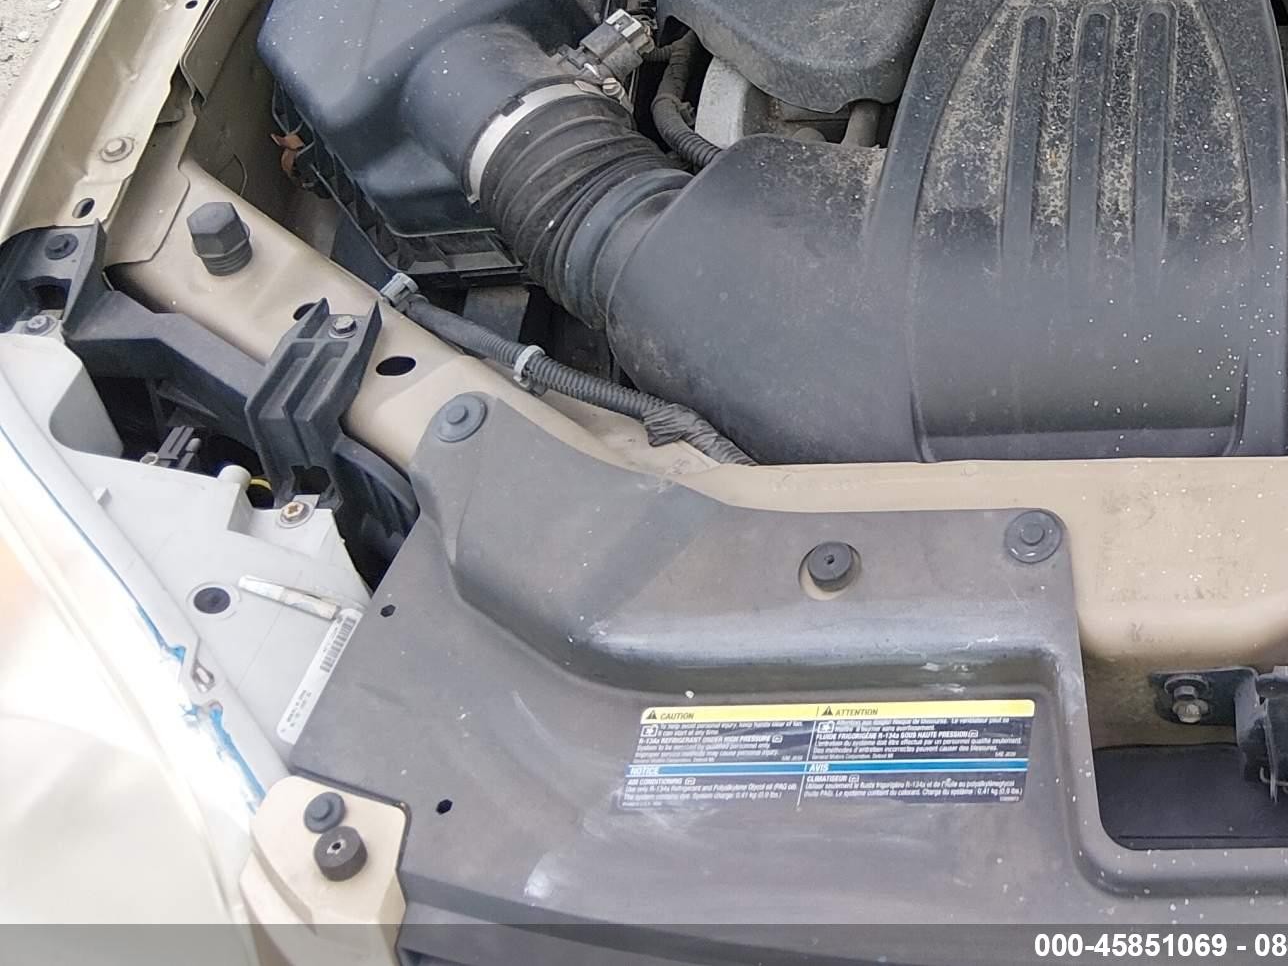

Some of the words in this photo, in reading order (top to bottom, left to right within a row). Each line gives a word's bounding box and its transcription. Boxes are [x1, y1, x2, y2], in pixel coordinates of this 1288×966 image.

[835, 708, 878, 716] ATTENTION
[660, 712, 695, 721] CAUTION
[630, 767, 660, 775] NOTICE
[809, 764, 830, 772] AVIS
